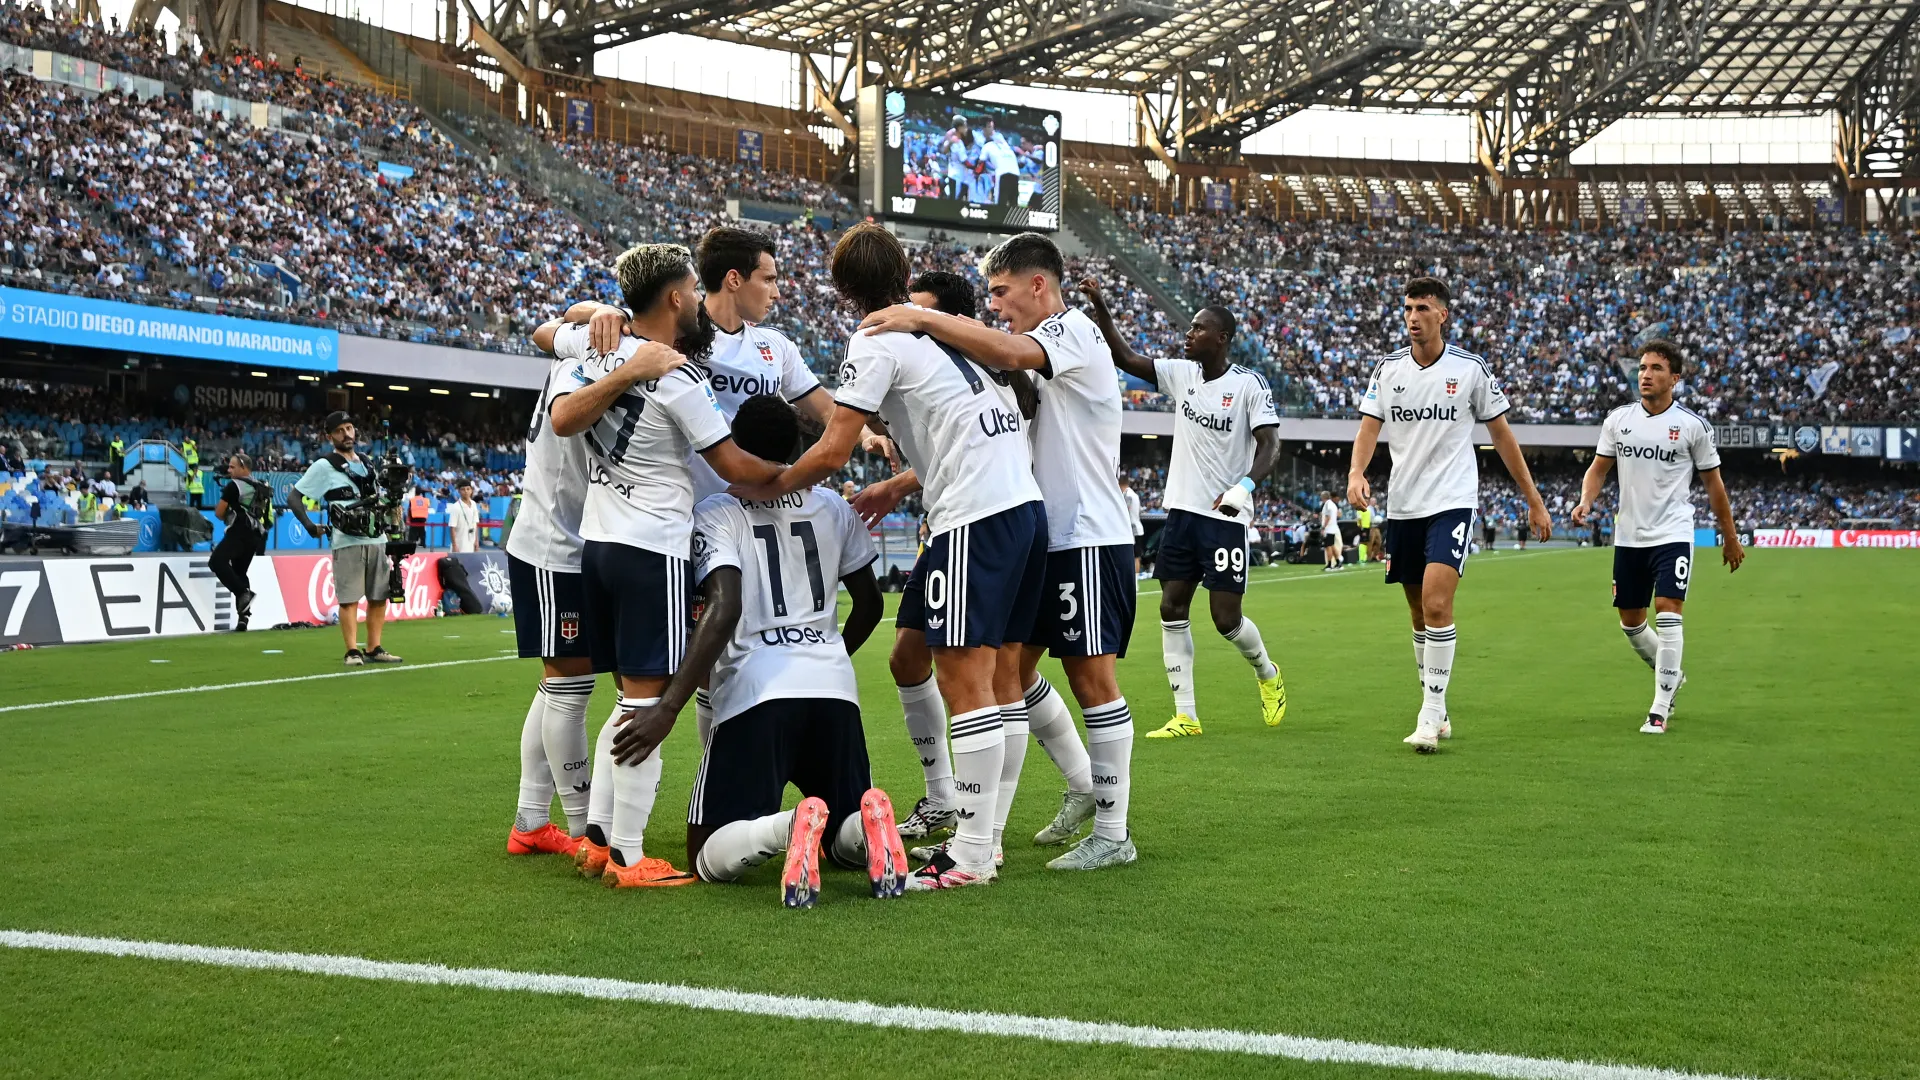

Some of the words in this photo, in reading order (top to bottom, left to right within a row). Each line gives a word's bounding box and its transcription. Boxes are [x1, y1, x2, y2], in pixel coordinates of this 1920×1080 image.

[12, 304, 78, 330] STADIO
[82, 313, 135, 336] DIEGO
[137, 320, 223, 346] ARMANDO
[226, 334, 313, 356] MARADONA
[194, 386, 228, 408] SSC
[231, 388, 287, 409] NAPOLI
[1182, 400, 1233, 432] Revolut
[1391, 404, 1457, 422] Revolut
[1616, 442, 1678, 462] Revolut
[1451, 521, 1466, 546] 4
[752, 520, 826, 617] 11
[1214, 547, 1244, 573] 99
[1674, 555, 1689, 580] 6
[1059, 582, 1078, 621] 3
